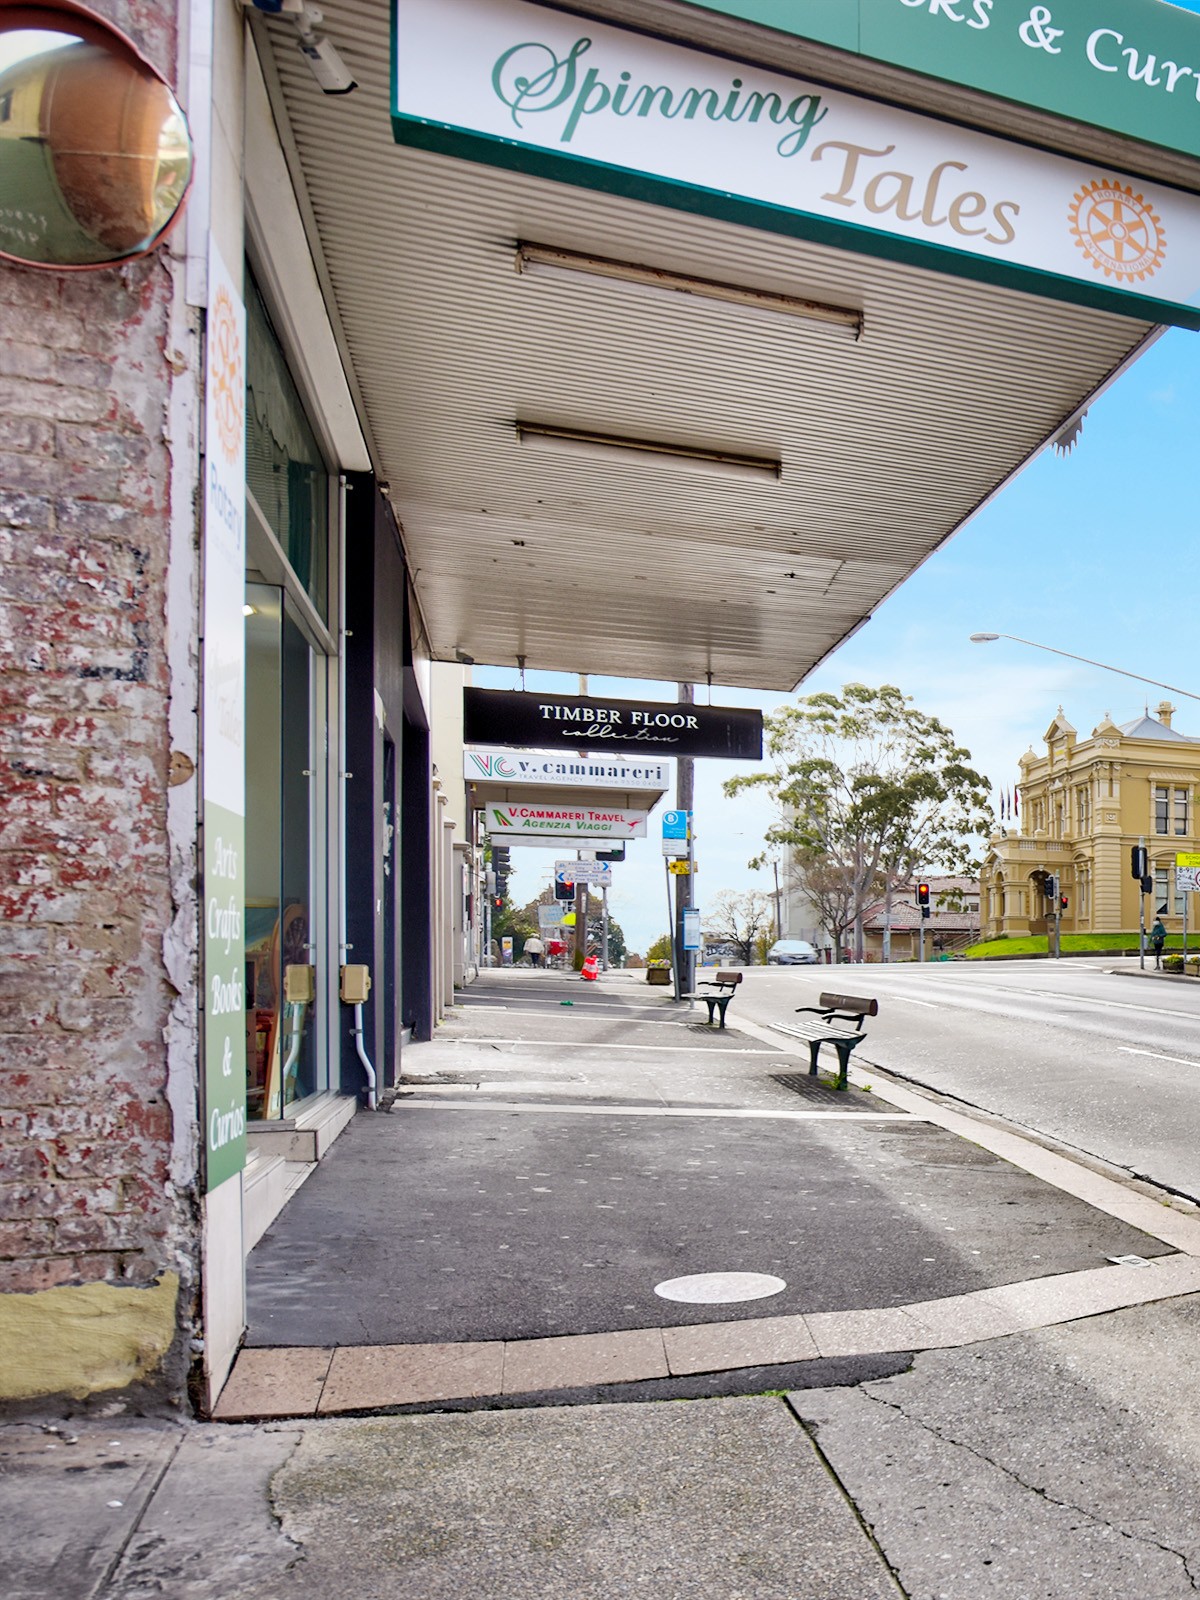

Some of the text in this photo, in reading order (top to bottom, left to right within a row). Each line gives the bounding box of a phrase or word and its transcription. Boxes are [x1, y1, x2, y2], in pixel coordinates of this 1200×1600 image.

[1018, 5, 1065, 54] &
[491, 37, 829, 158] Spinning
[810, 141, 1021, 245] Tales
[1097, 190, 1139, 207] ROTARY
[1084, 238, 1154, 271] INTERNATIONAL
[211, 462, 242, 551] Rotary
[539, 704, 699, 729] TIMBER FLOOR
[562, 724, 680, 743] collection
[518, 761, 662, 780] v. cammareri
[522, 819, 612, 831] AGENZIA VIAGGI
[588, 811, 625, 822] TRAVEL
[212, 836, 238, 881] Arts
[208, 895, 241, 955] Crafts
[211, 967, 242, 1016] Books
[222, 1036, 233, 1077] &
[210, 1099, 244, 1151] Curios
